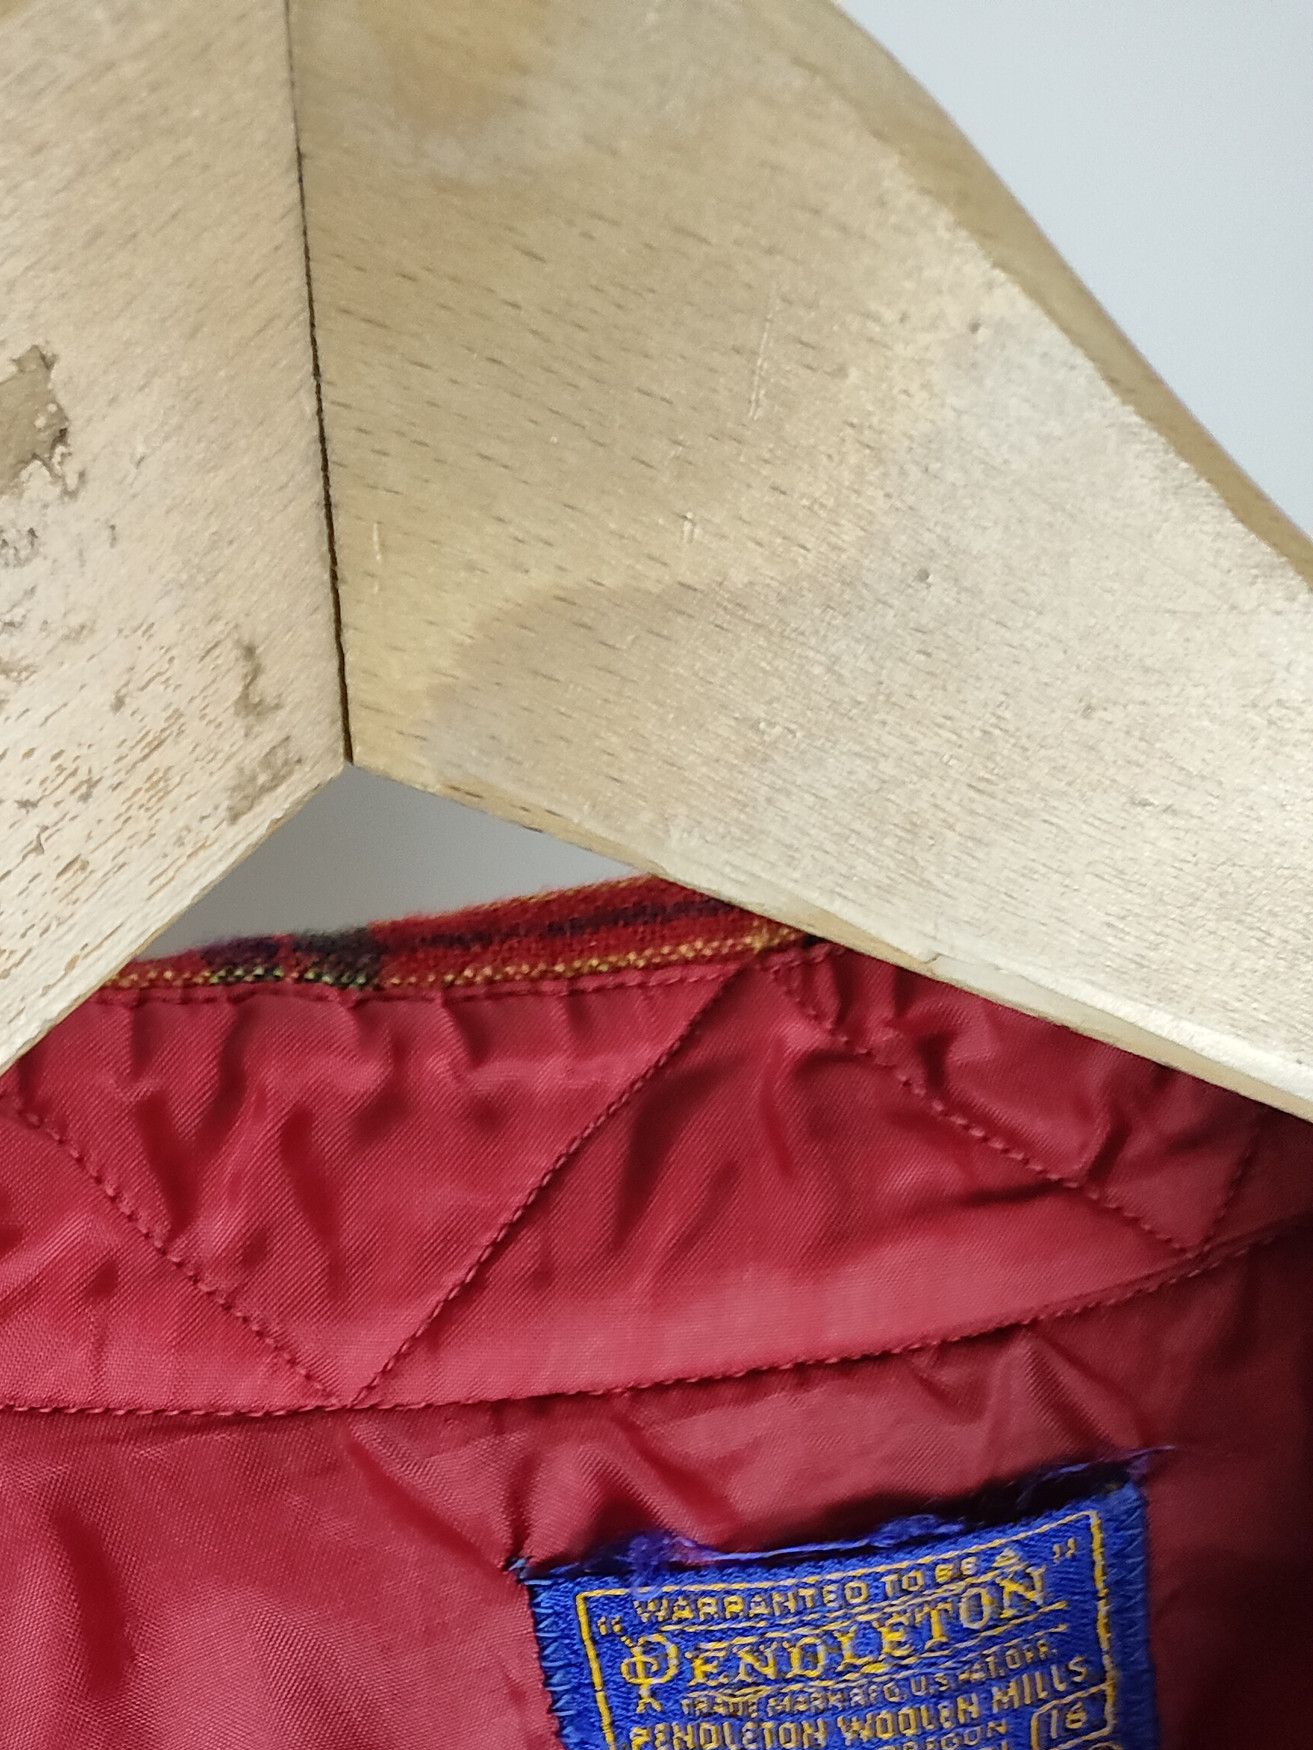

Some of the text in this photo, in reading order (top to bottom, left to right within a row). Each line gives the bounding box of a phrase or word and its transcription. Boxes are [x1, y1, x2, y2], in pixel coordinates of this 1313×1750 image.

[633, 1548, 1021, 1622] WARRANTED TO BE A
[836, 1692, 981, 1745] WOOLEN
[991, 1655, 1089, 1714] MILLS
